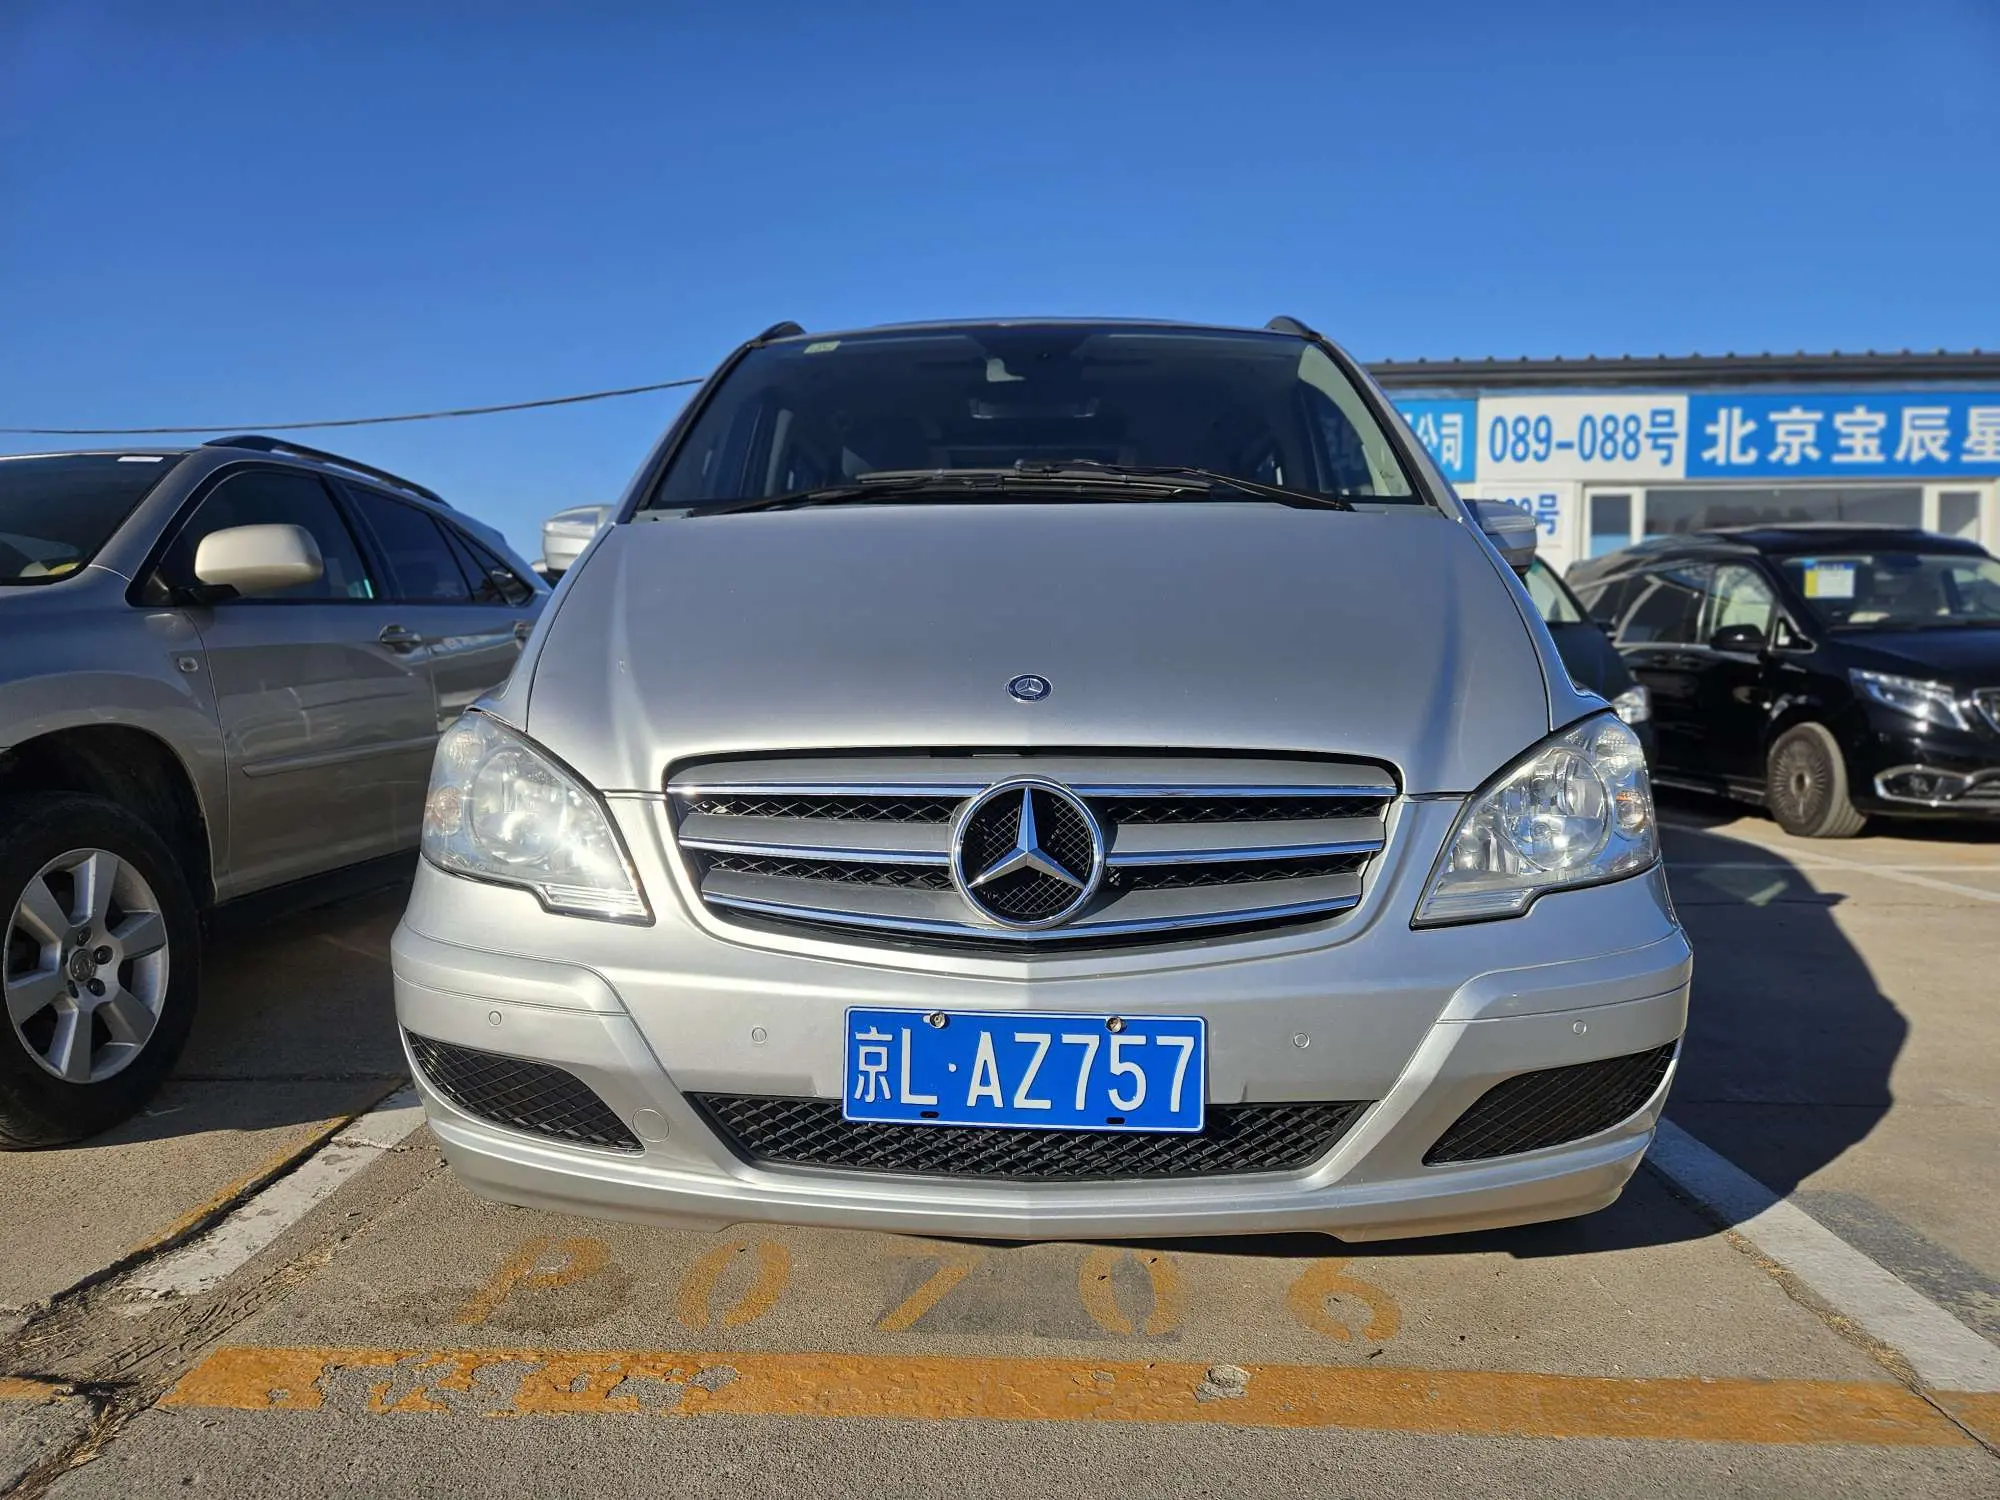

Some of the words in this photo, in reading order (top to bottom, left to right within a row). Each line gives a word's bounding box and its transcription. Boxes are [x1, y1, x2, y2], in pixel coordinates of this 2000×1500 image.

[1403, 412, 1463, 471] 公司
[1489, 408, 1679, 467] 089-088号
[1701, 405, 2000, 465] 北京宝辰星
[853, 1026, 1195, 1113] 京L·AZ757
